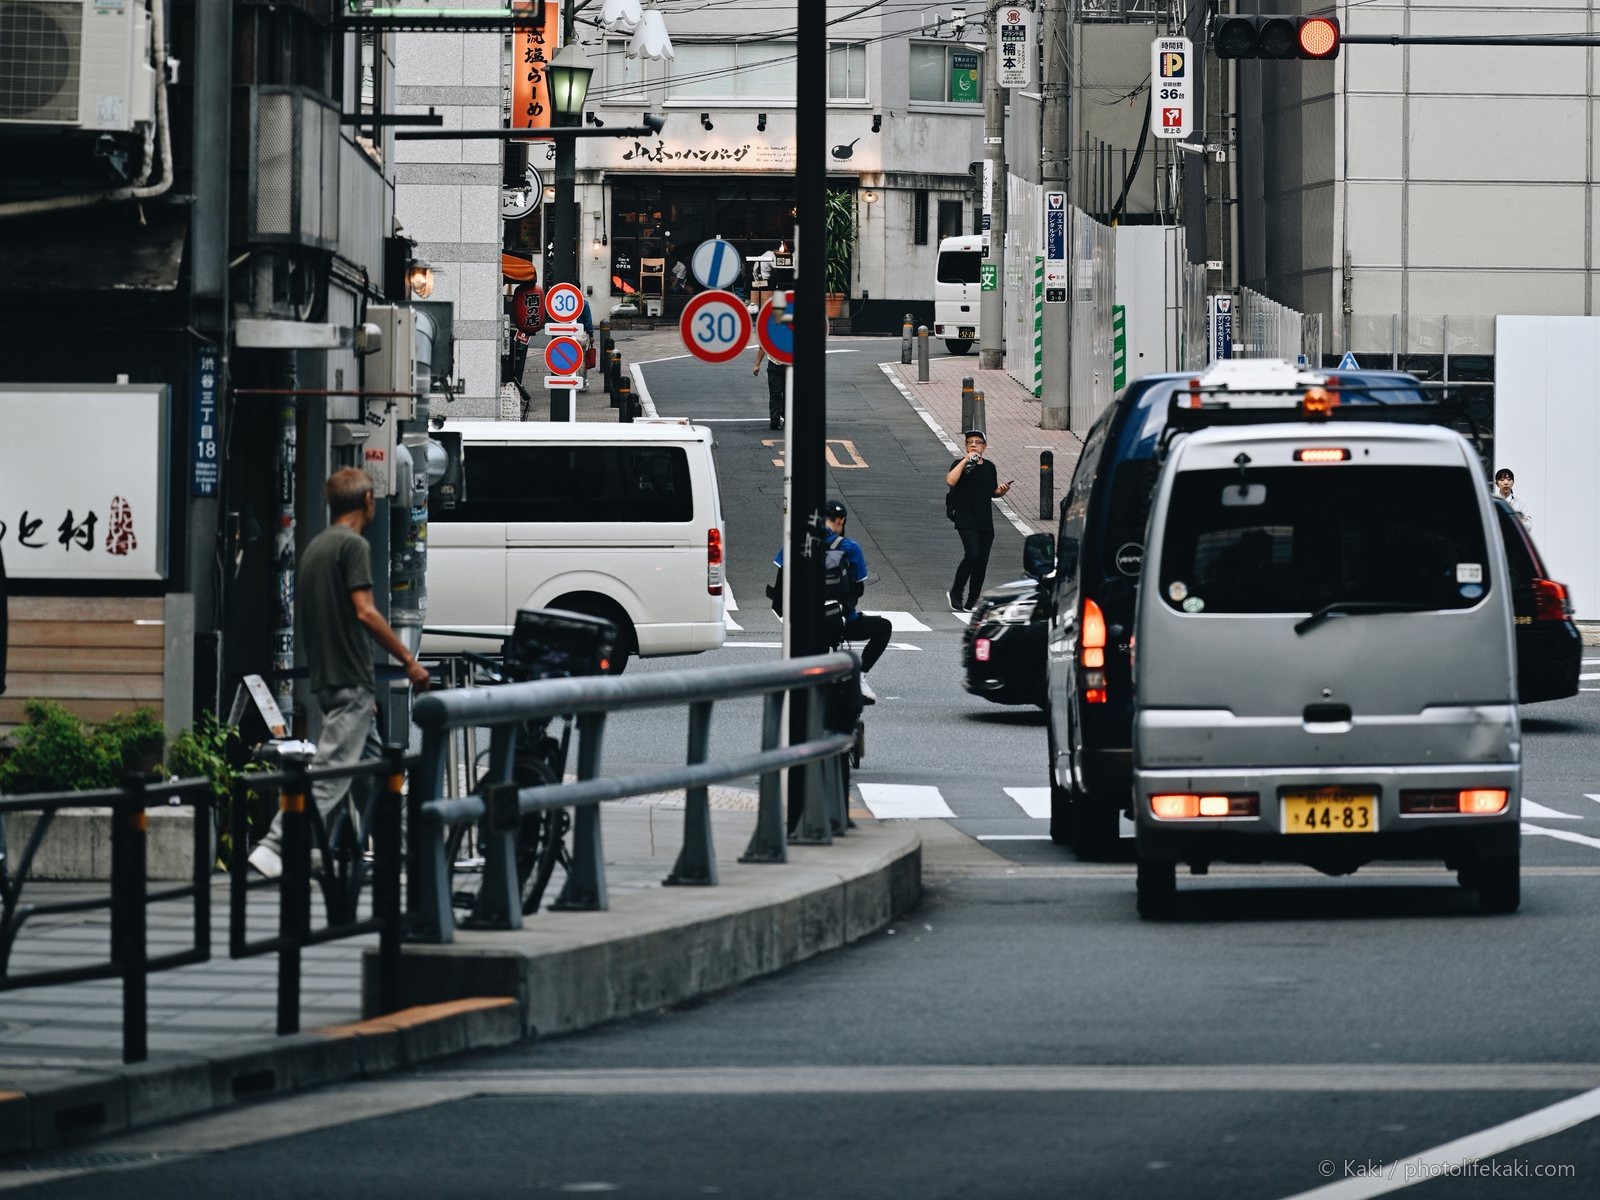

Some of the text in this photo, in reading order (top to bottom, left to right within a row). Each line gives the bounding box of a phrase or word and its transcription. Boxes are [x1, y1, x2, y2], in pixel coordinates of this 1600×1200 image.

[1003, 43, 1016, 69] 楠本
[1161, 42, 1184, 50] 時間貸
[622, 140, 751, 162] 山本のハンバーグ
[554, 295, 576, 311] 30
[697, 312, 736, 343] 30
[201, 356, 214, 440] 渋谷三丁目
[197, 441, 216, 459] 18
[1305, 806, 1368, 828] 44-83
